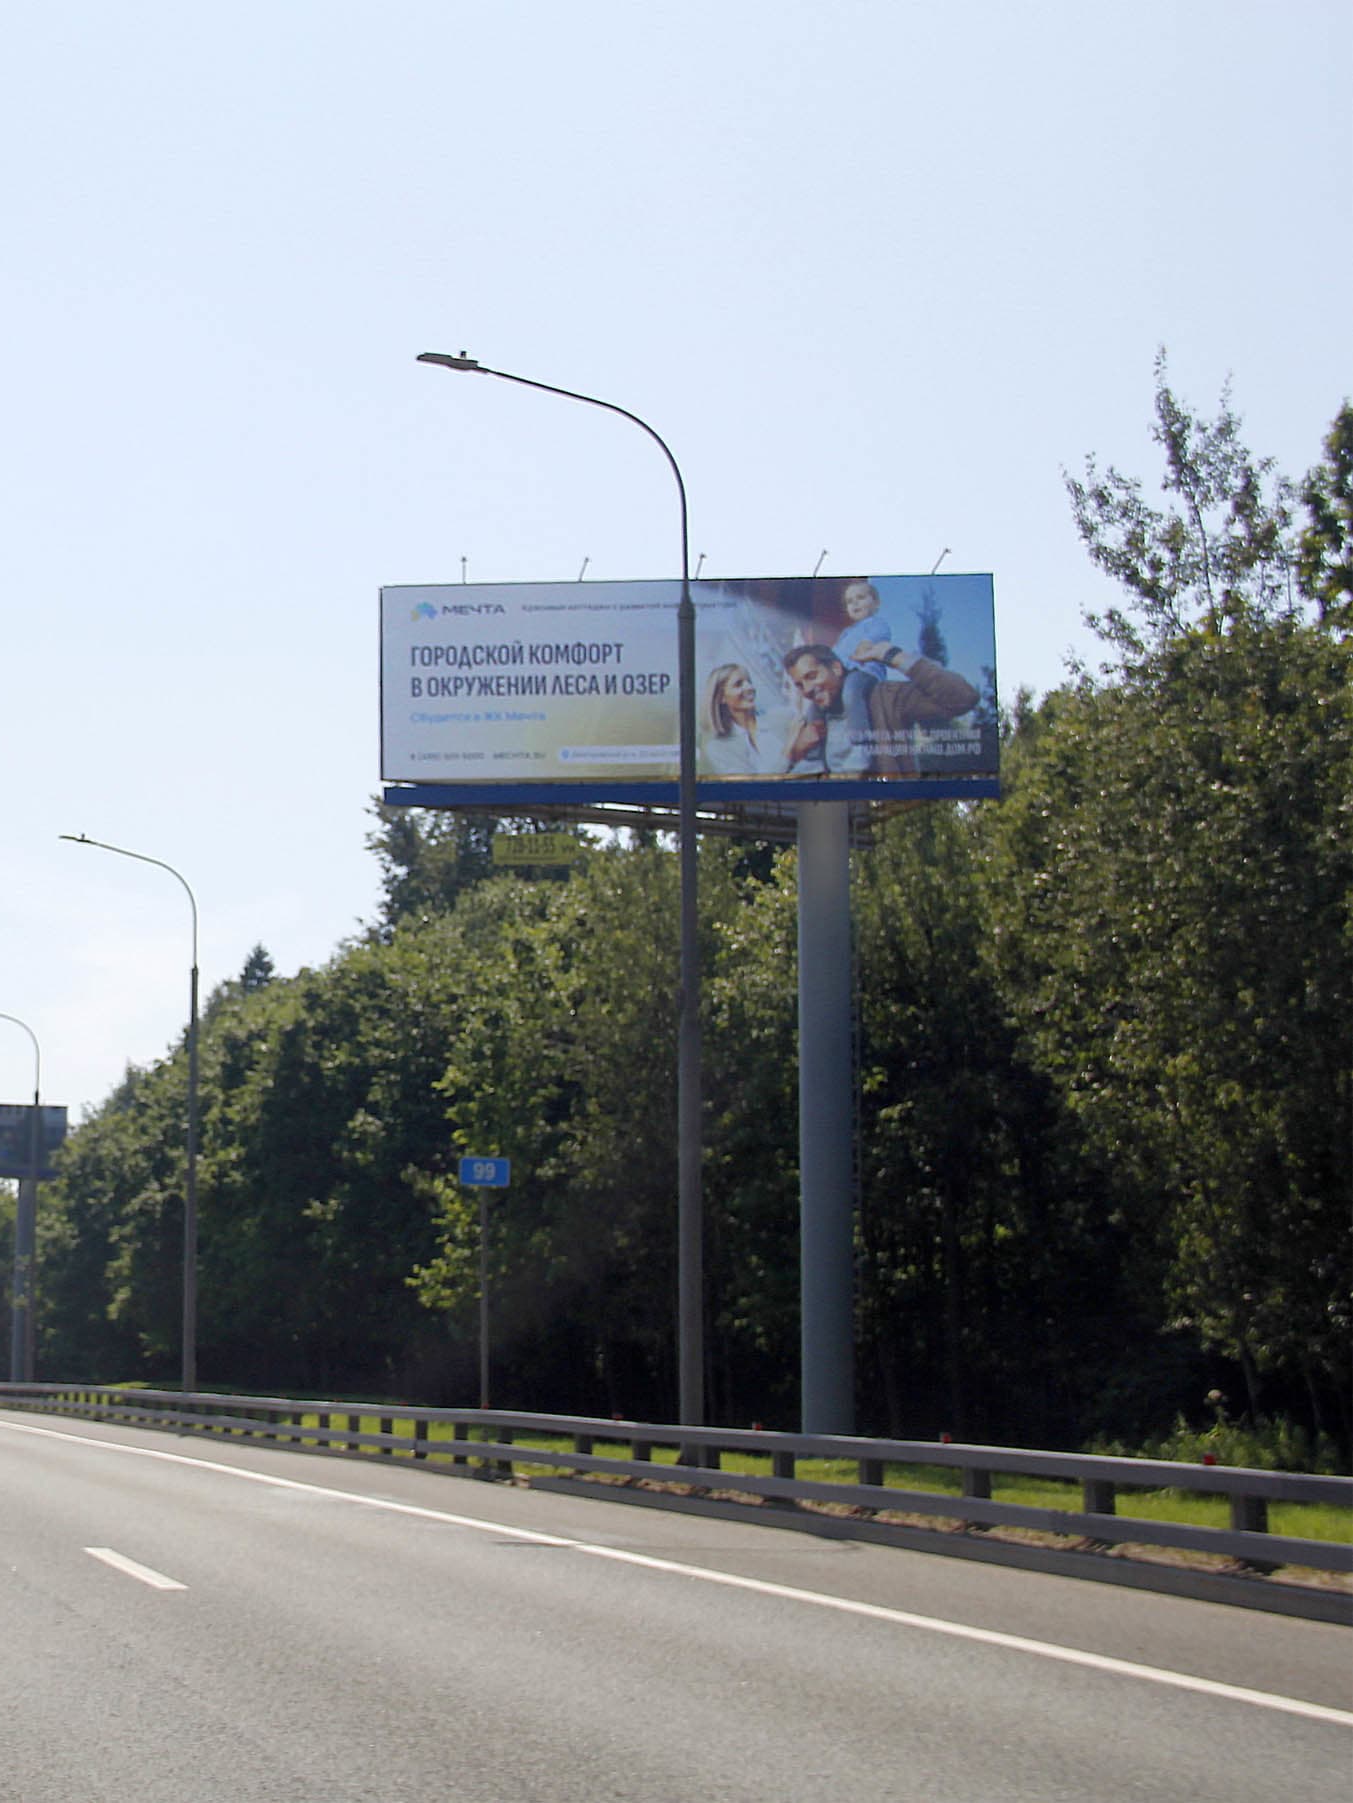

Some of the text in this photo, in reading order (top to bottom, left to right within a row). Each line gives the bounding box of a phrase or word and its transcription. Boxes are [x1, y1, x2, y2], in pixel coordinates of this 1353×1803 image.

[442, 604, 506, 616] МЕЧТА
[411, 640, 624, 669] ГОРОДСКОЙ КОМФОРТ
[411, 674, 670, 698] В ОКРУЖЕНИИ ЛЕСА И ОЗЕР
[473, 1162, 496, 1181] 99
